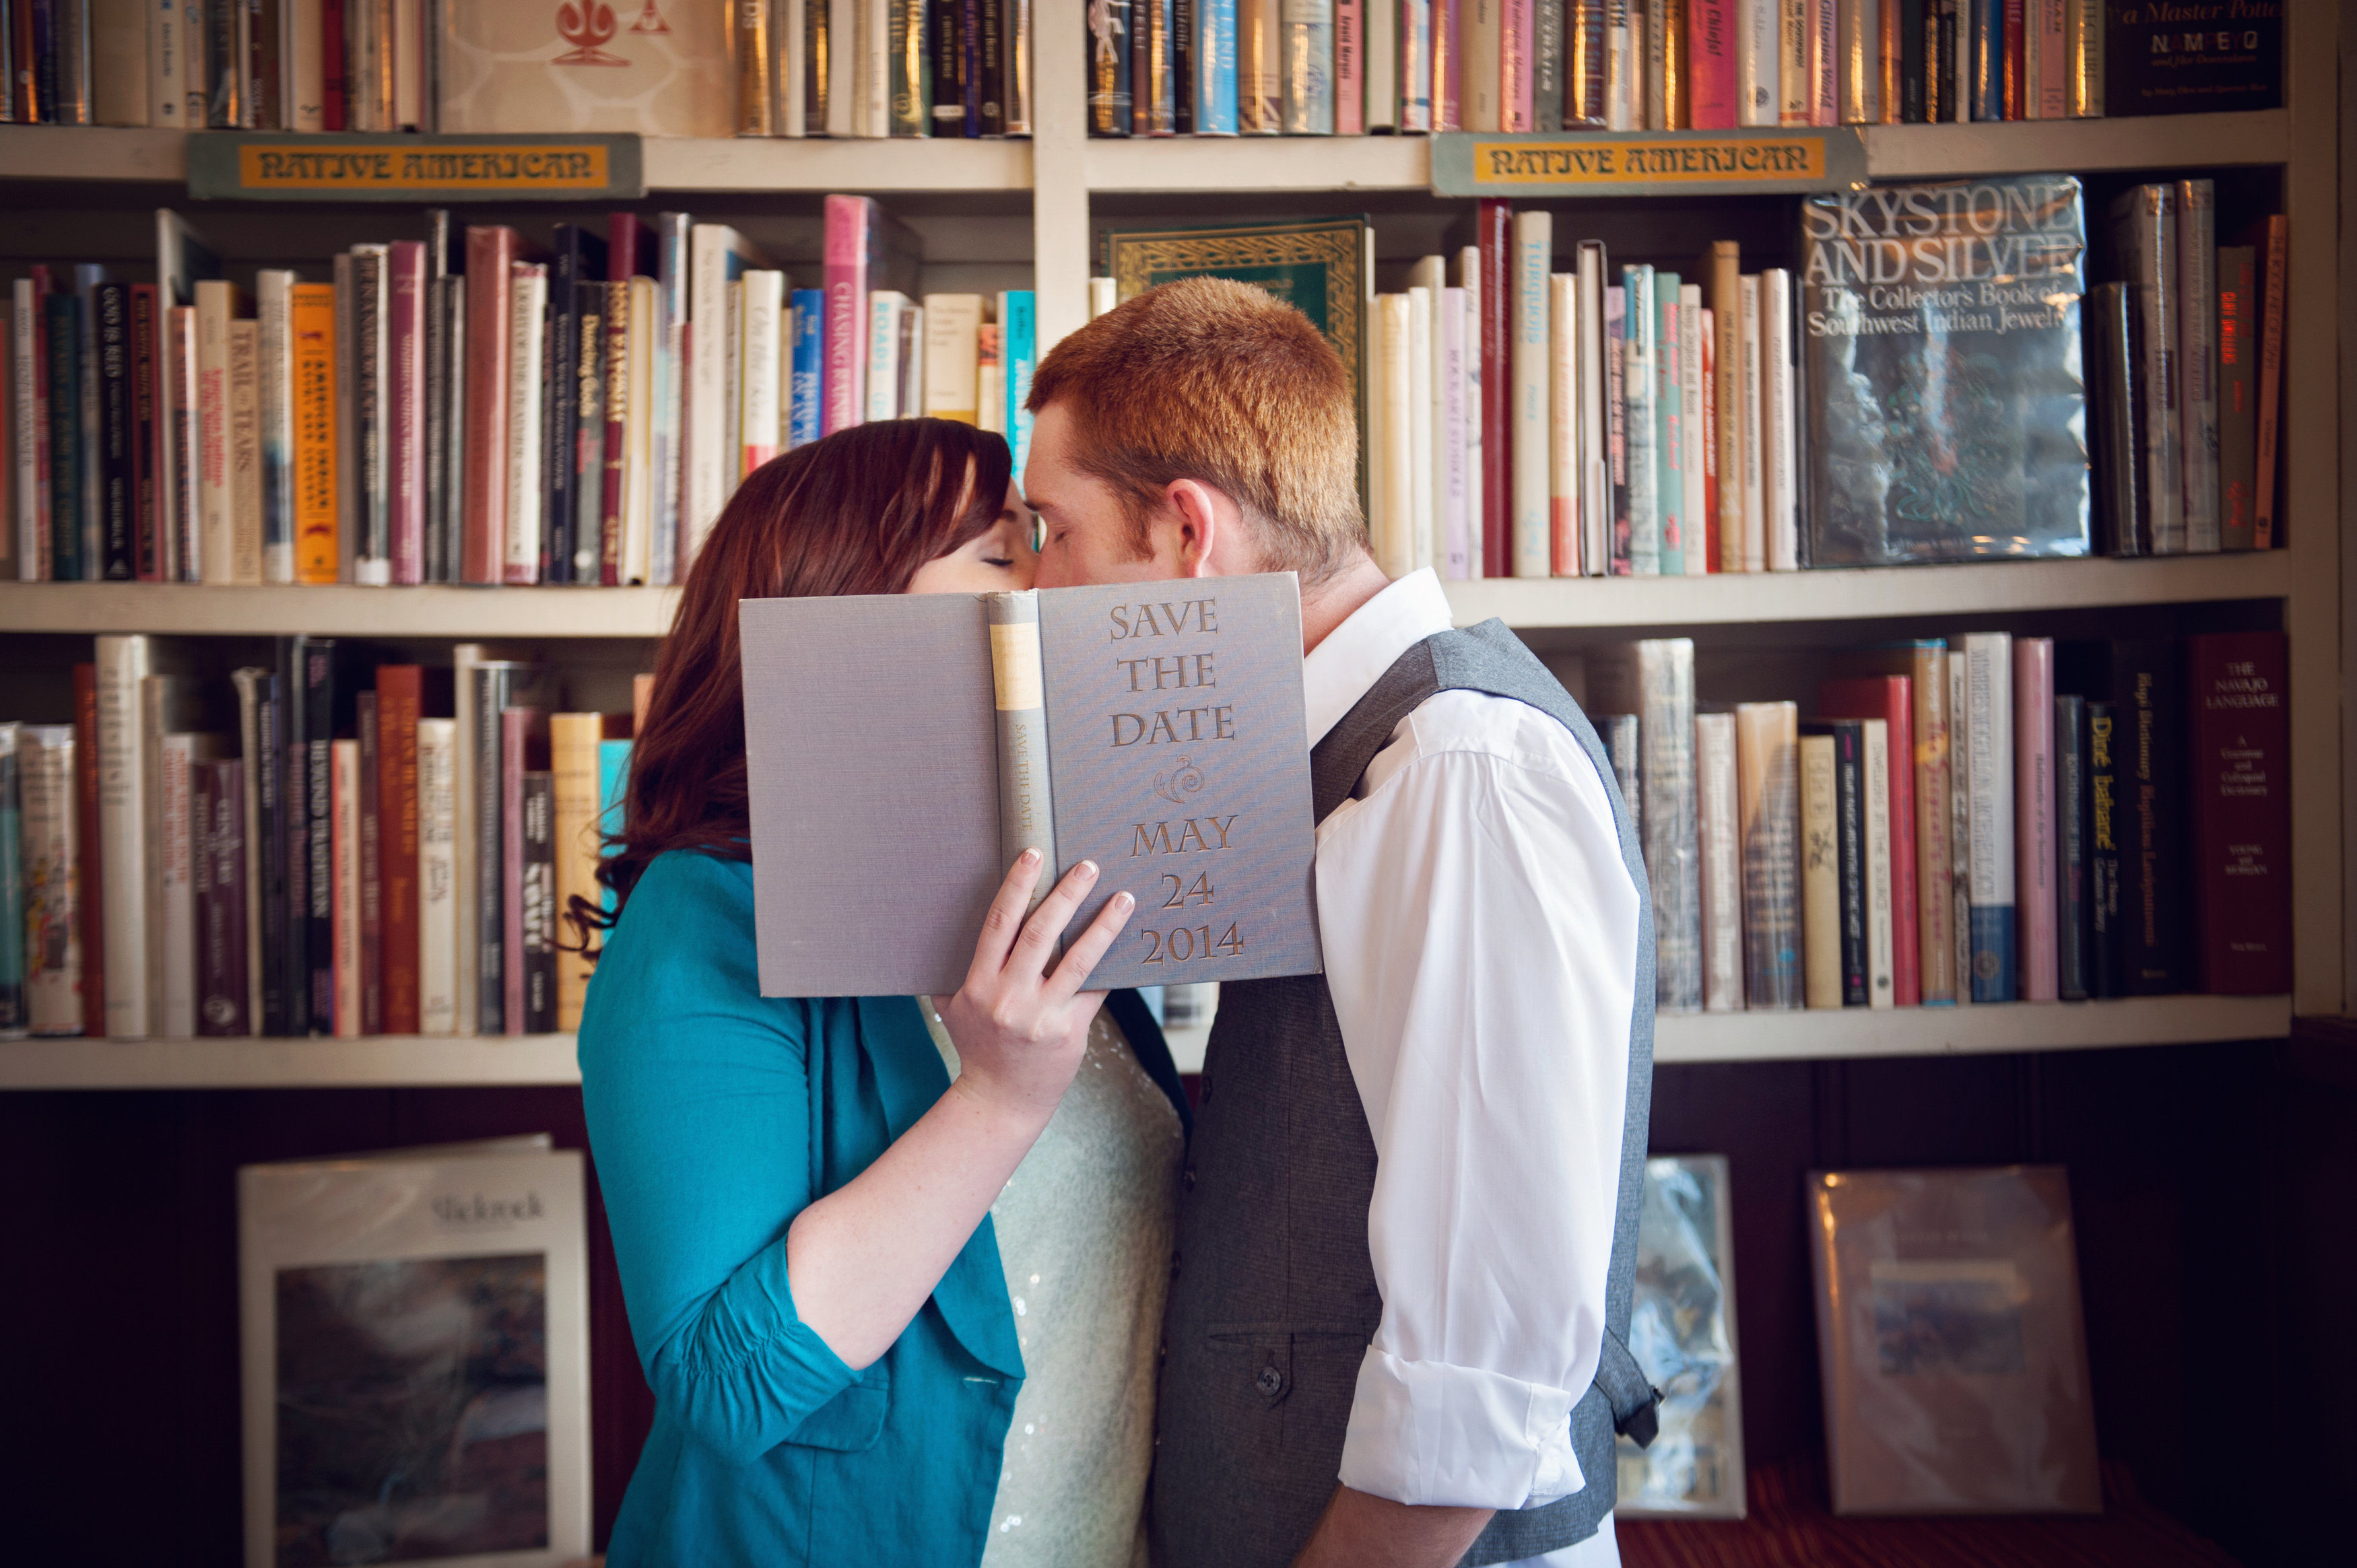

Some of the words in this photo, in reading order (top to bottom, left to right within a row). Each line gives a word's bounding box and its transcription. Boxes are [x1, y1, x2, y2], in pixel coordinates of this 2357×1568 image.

[2144, 2, 2223, 24] Master
[258, 152, 393, 179] NATIVE
[402, 152, 592, 179] AMERICAN
[1489, 149, 1614, 175] NATIVE
[1625, 143, 1809, 174] AMERICAN
[1803, 239, 1908, 287] AND
[1979, 281, 2036, 307] Book
[831, 281, 853, 365] CHASING
[873, 302, 890, 371] ROADS
[232, 330, 254, 386] TRAIL
[234, 409, 255, 472] TEARS
[1110, 596, 1218, 644] SAVE
[1116, 652, 1216, 693] THE
[2215, 677, 2268, 693] NAVAJO
[2225, 661, 2255, 675] THE
[2205, 693, 2280, 709] LANGUAGE
[1016, 724, 1028, 757] SAVE
[1109, 704, 1235, 748] DATE
[1018, 759, 1030, 791] THE
[1020, 793, 1034, 831] DATE
[1129, 815, 1238, 858] MAY
[1162, 870, 1214, 910] 24
[1141, 920, 1244, 966] 2014
